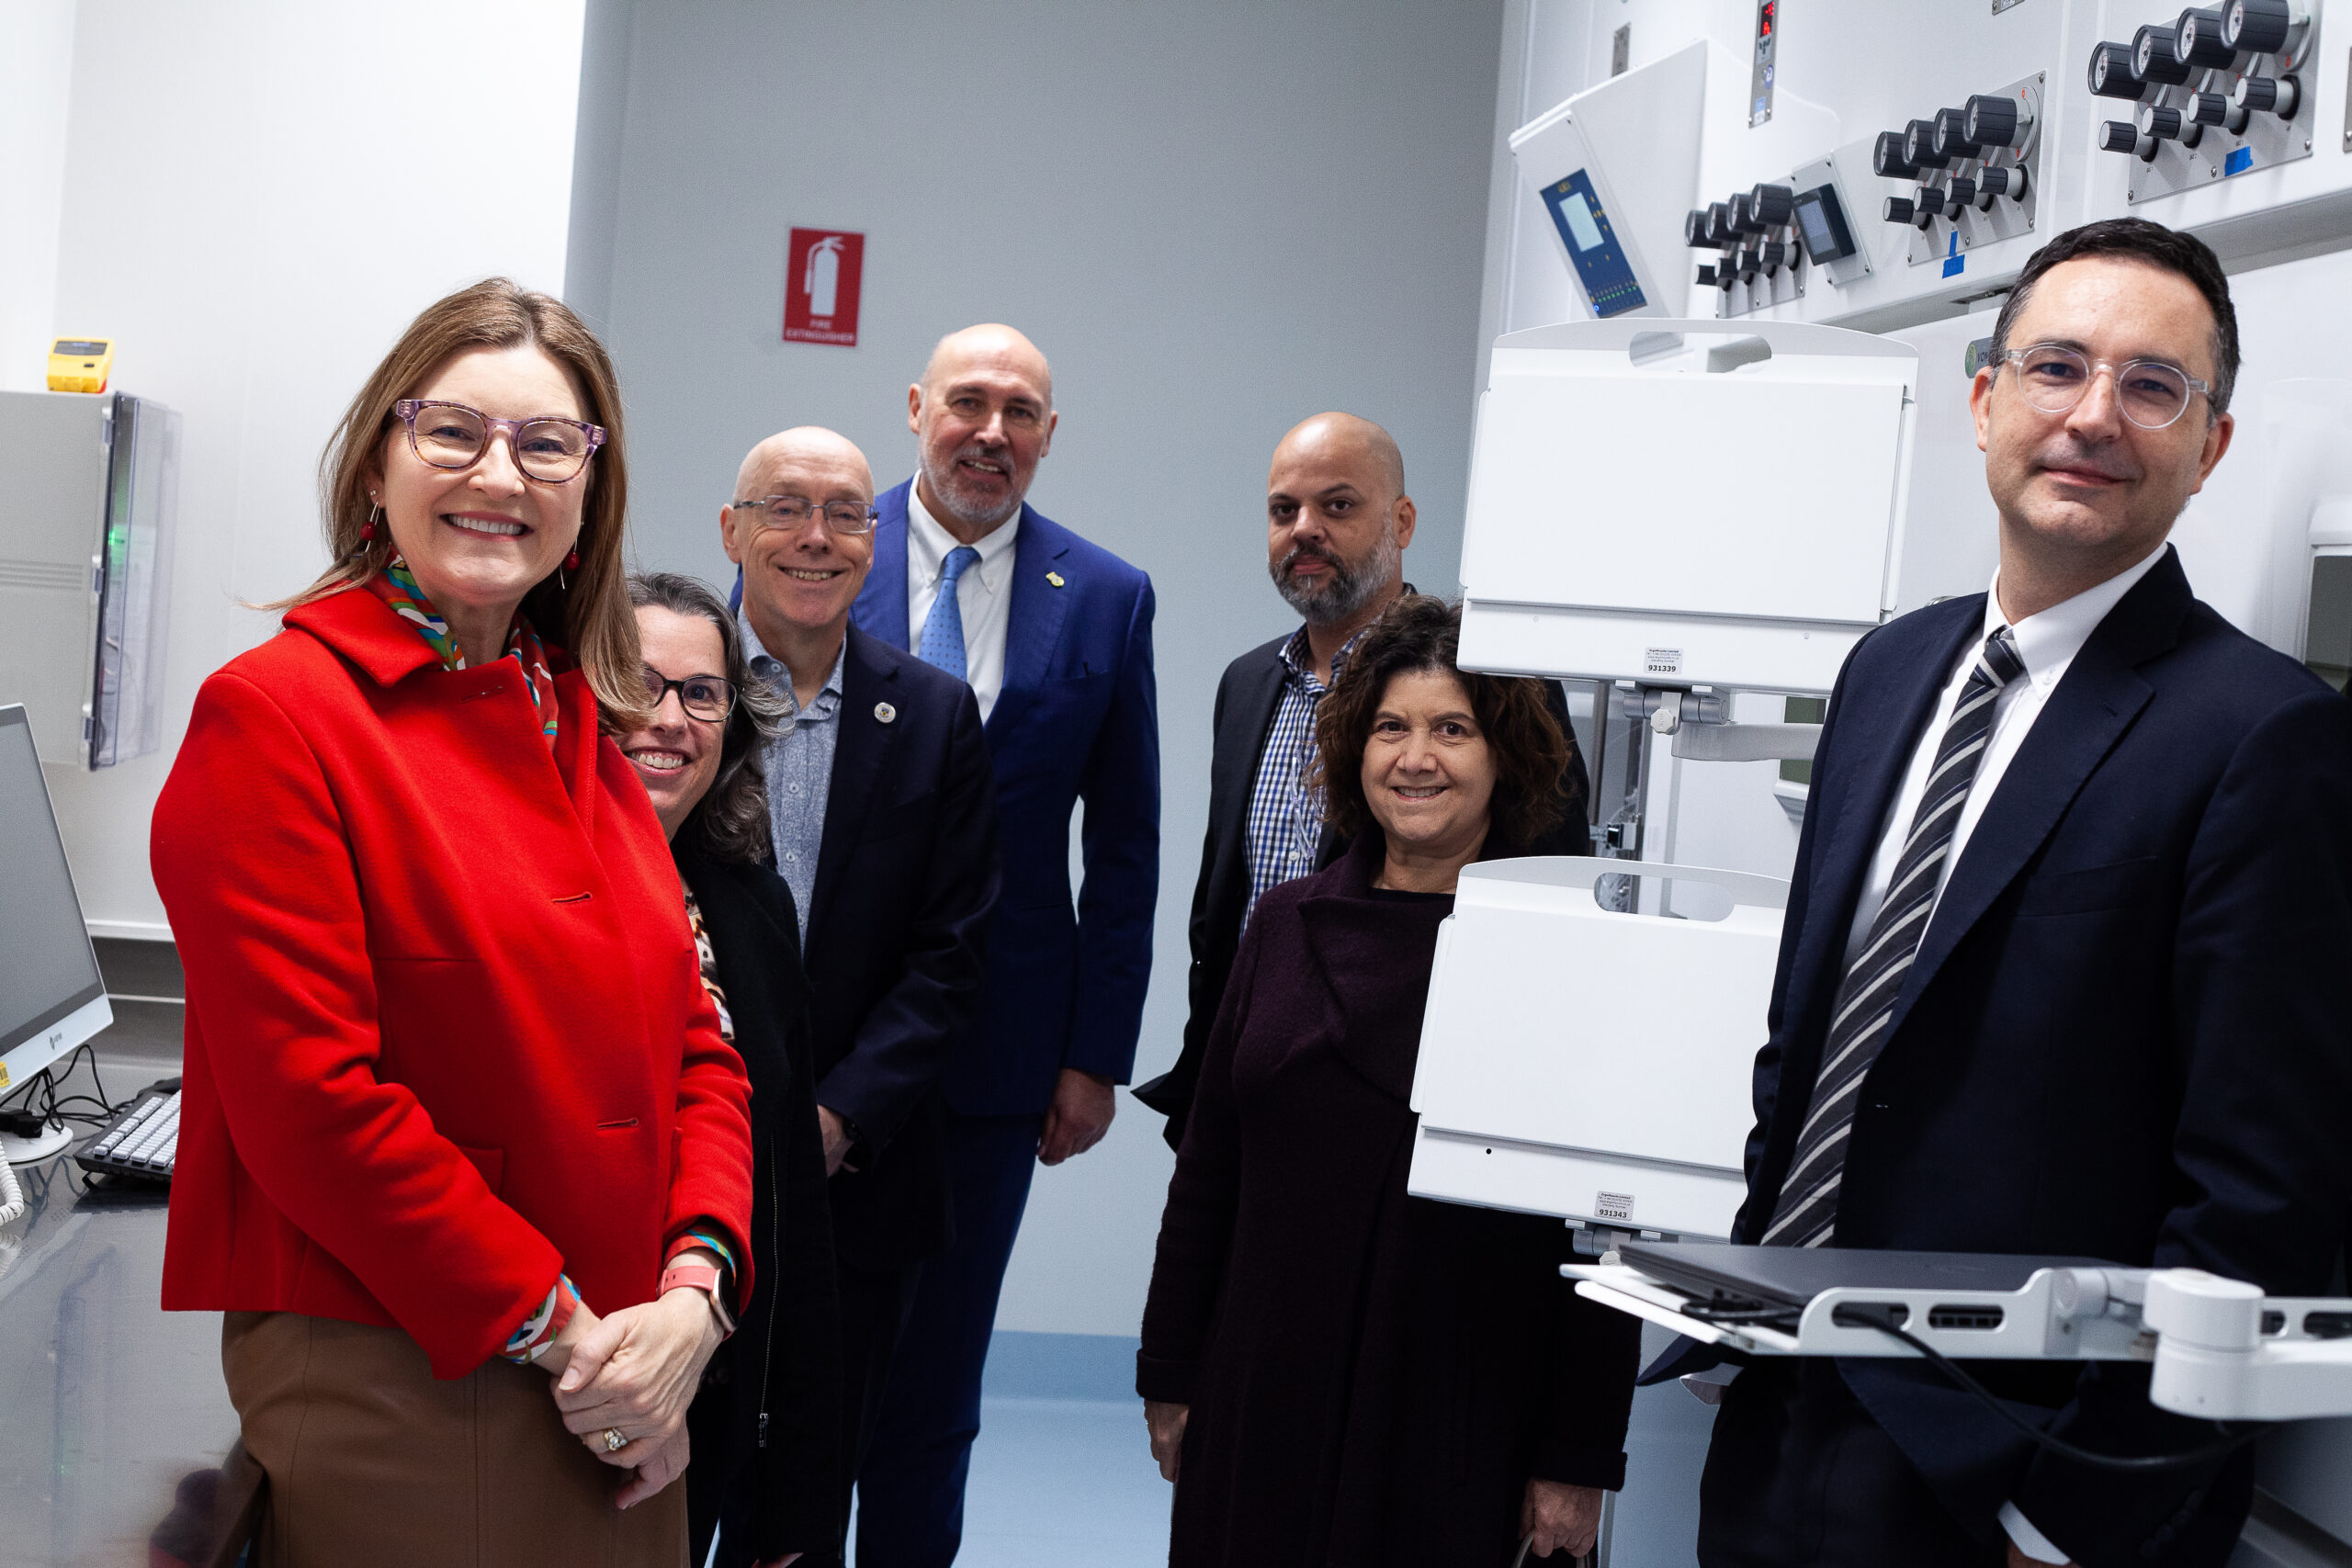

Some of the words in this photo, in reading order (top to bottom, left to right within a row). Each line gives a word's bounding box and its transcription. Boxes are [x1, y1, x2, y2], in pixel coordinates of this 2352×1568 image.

[809, 320, 831, 329] FIRE
[786, 328, 854, 342] EXTINGUISHER
[1648, 664, 1677, 672] 931339
[1599, 1209, 1627, 1218] 931343
